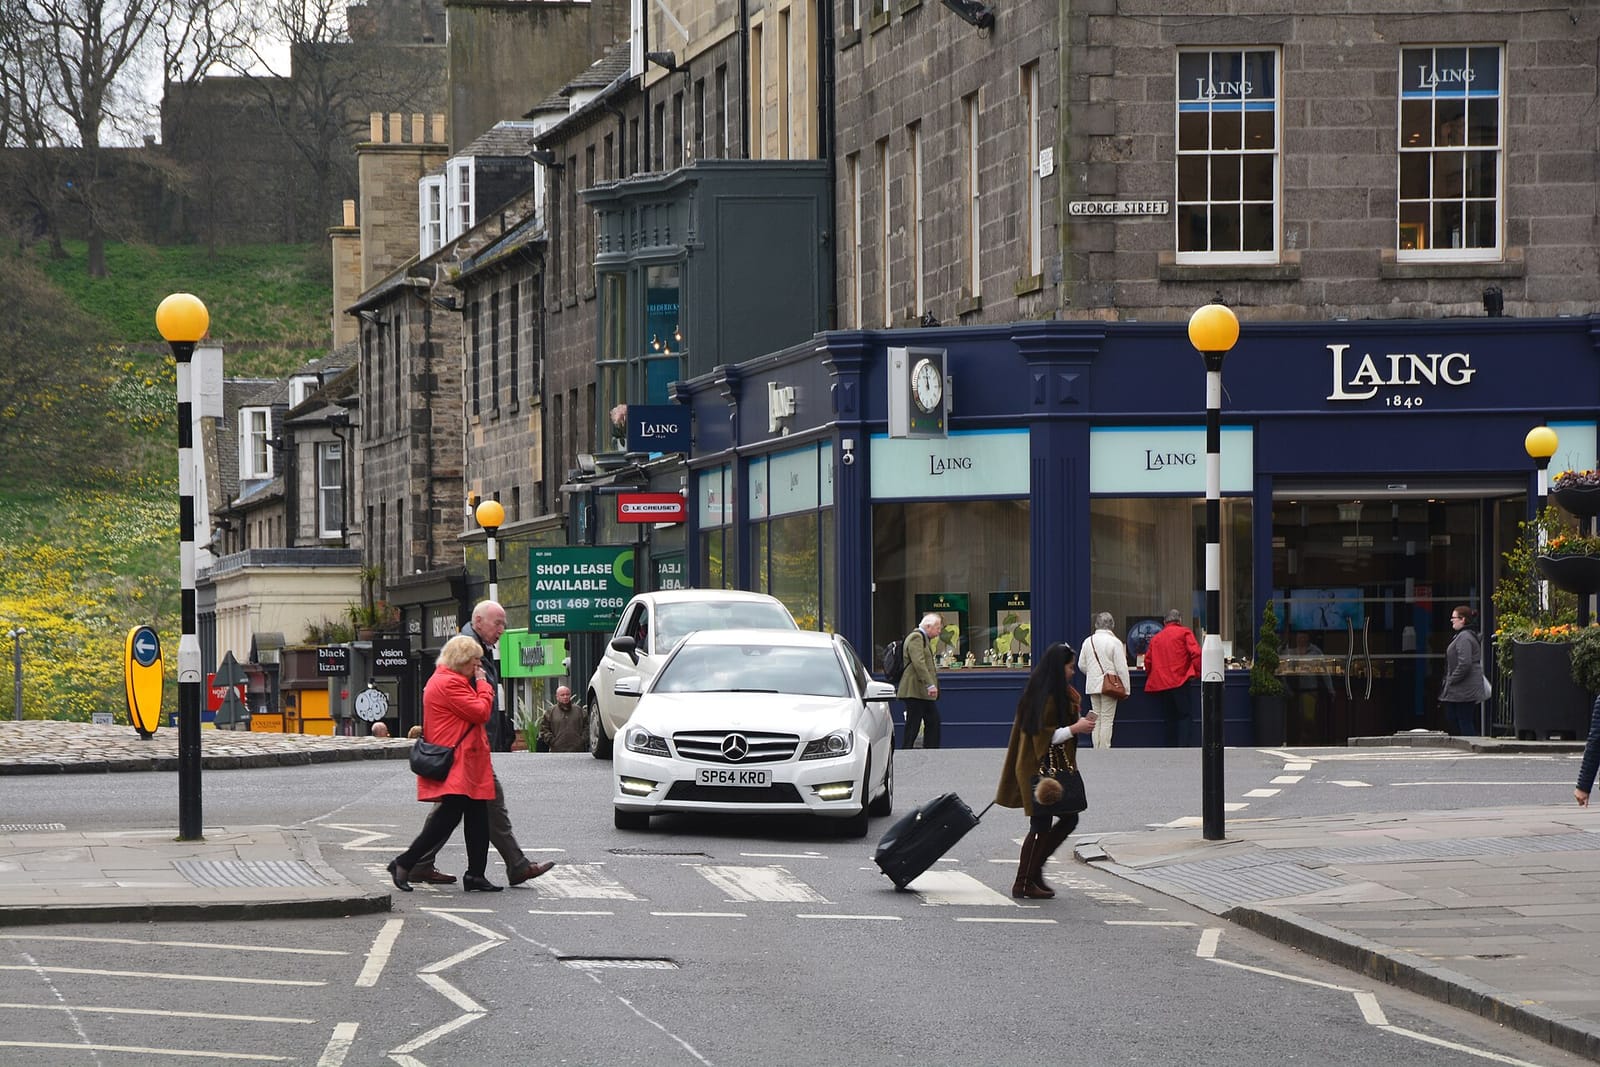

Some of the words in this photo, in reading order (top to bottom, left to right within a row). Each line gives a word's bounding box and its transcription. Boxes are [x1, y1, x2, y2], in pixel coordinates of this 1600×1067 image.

[1418, 65, 1476, 88] LAING
[1196, 78, 1254, 101] LAING
[1072, 202, 1118, 214] GEORGE
[1124, 202, 1166, 214] STREET
[1326, 344, 1476, 400] LAING
[1386, 395, 1423, 408] 1840
[640, 421, 678, 437] LAING
[929, 454, 972, 475] LAING
[1145, 449, 1198, 471] LAING
[536, 564, 570, 575] SHOP
[573, 564, 612, 574] LEASE
[535, 579, 607, 591] AVAILABLE
[536, 599, 562, 610] 0131
[566, 598, 590, 609] 469
[594, 597, 624, 608] 7666
[535, 614, 566, 624] CBRE
[319, 648, 345, 658] black
[380, 648, 404, 657] vision
[319, 663, 345, 671] lizars
[701, 770, 736, 783] SP64
[739, 771, 766, 784] KRO
